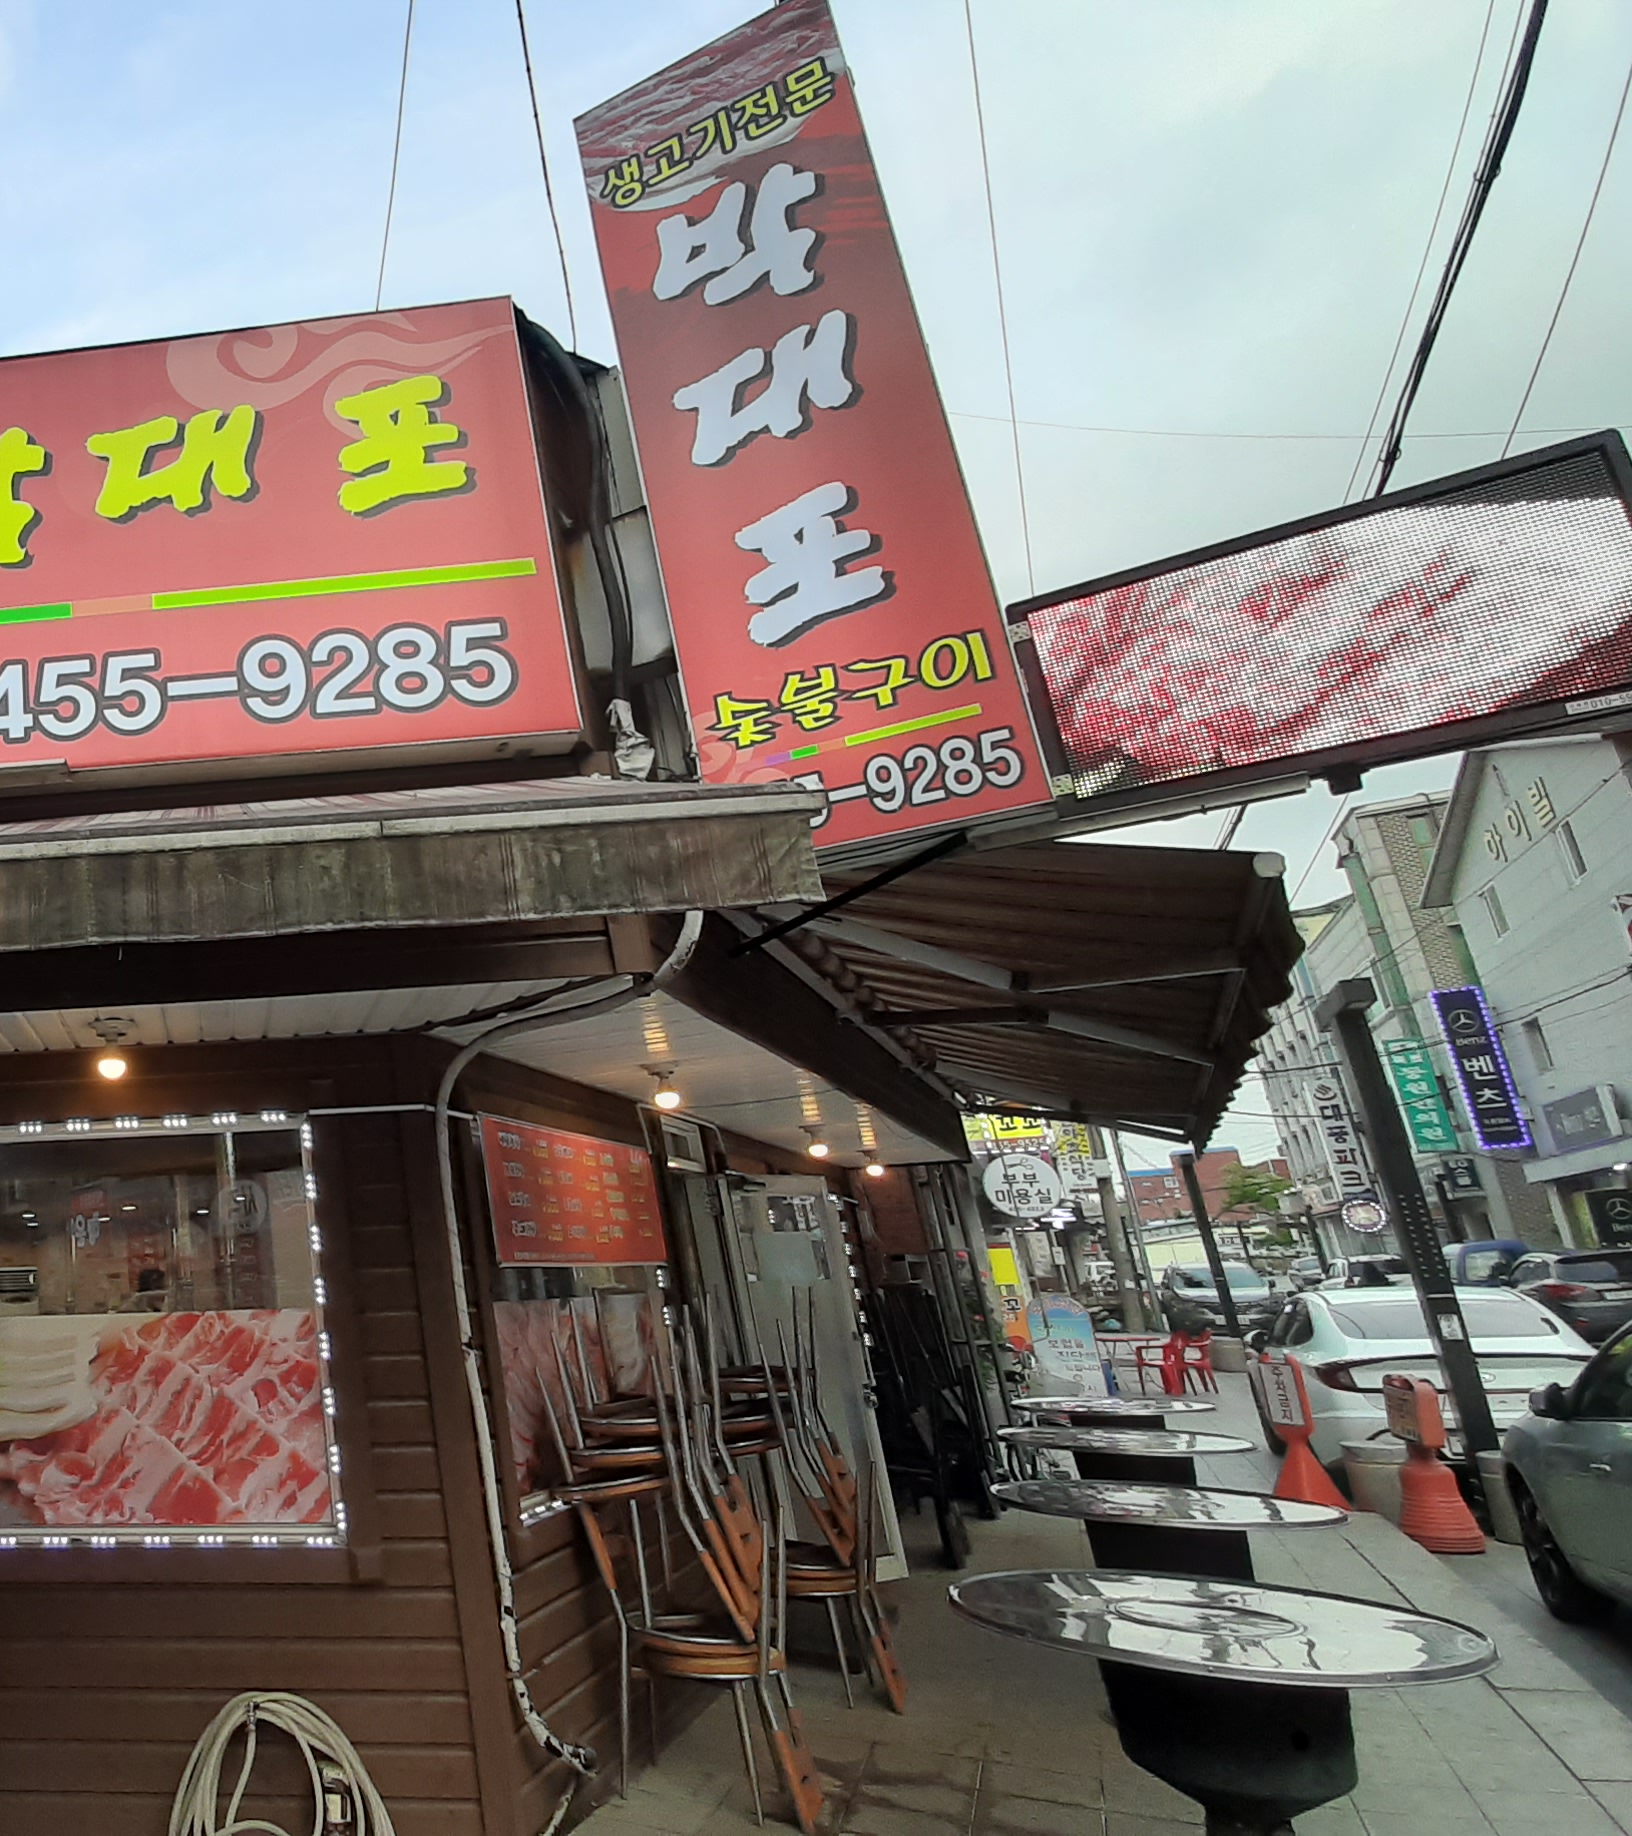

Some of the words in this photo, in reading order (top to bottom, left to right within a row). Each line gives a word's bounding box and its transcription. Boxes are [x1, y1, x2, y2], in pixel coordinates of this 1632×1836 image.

[601, 57, 835, 208] 생고기전문
[652, 162, 888, 648] 박대포
[1455, 1035, 1489, 1047] Benz
[1461, 1053, 1508, 1110] 벤츠
[995, 1187, 1054, 1206] 미용실
[1001, 1172, 1040, 1188] 부부
[1271, 1365, 1294, 1423] 주차금지
